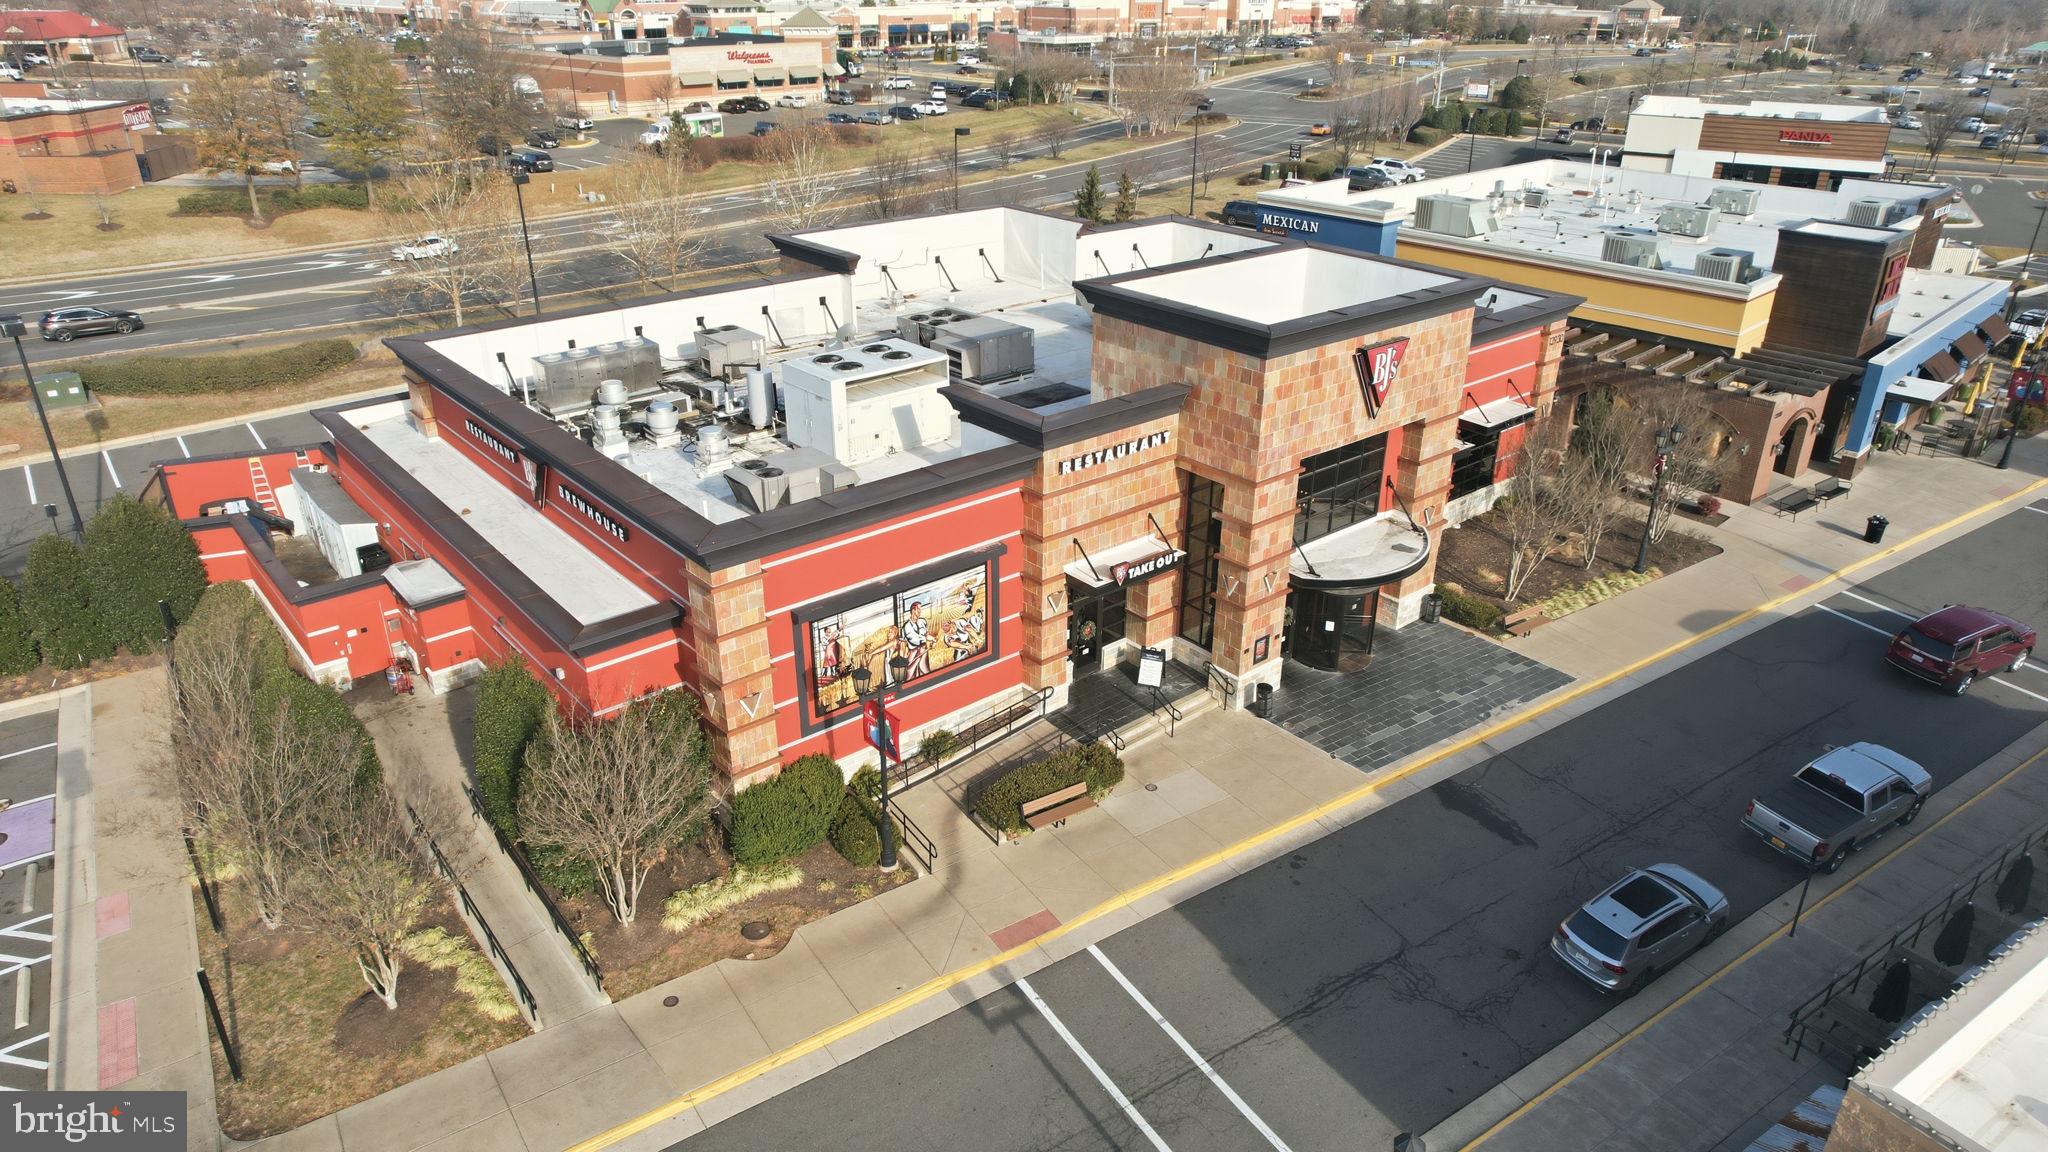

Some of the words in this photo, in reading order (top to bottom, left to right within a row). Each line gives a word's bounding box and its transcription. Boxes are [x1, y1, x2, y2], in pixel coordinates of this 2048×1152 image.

[727, 50, 770, 62] Walgreens
[1780, 129, 1832, 142] PANDA
[1262, 213, 1319, 233] MEXICAN
[465, 419, 515, 463] RESTAURANT
[1061, 431, 1171, 475] RESTAURANT
[558, 485, 625, 542] BREWHOUSE
[1128, 561, 1155, 579] TAKE
[1156, 551, 1181, 569] OUT
